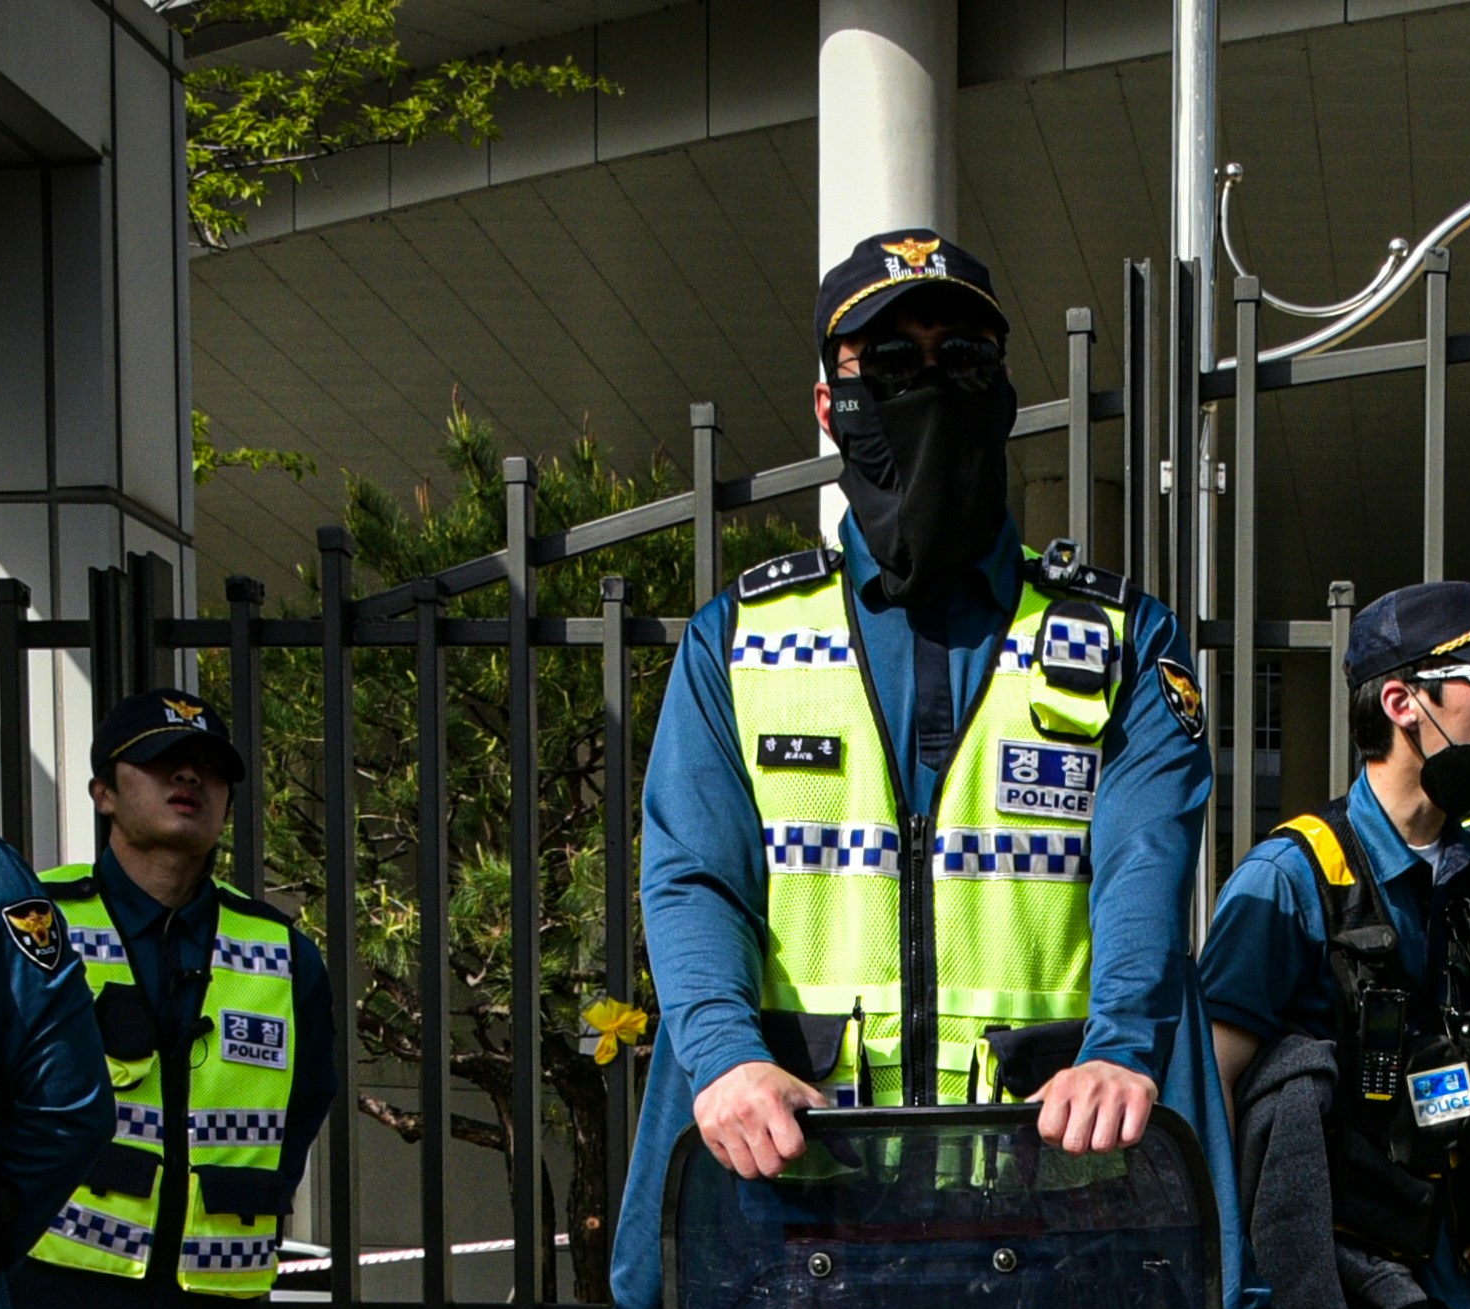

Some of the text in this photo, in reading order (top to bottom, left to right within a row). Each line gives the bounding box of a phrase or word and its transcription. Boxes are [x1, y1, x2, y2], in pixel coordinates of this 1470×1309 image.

[1009, 748, 1091, 789] 경찰
[1006, 789, 1090, 812] POLICE
[228, 1015, 283, 1046] 경찰
[228, 1043, 281, 1063] POLICE
